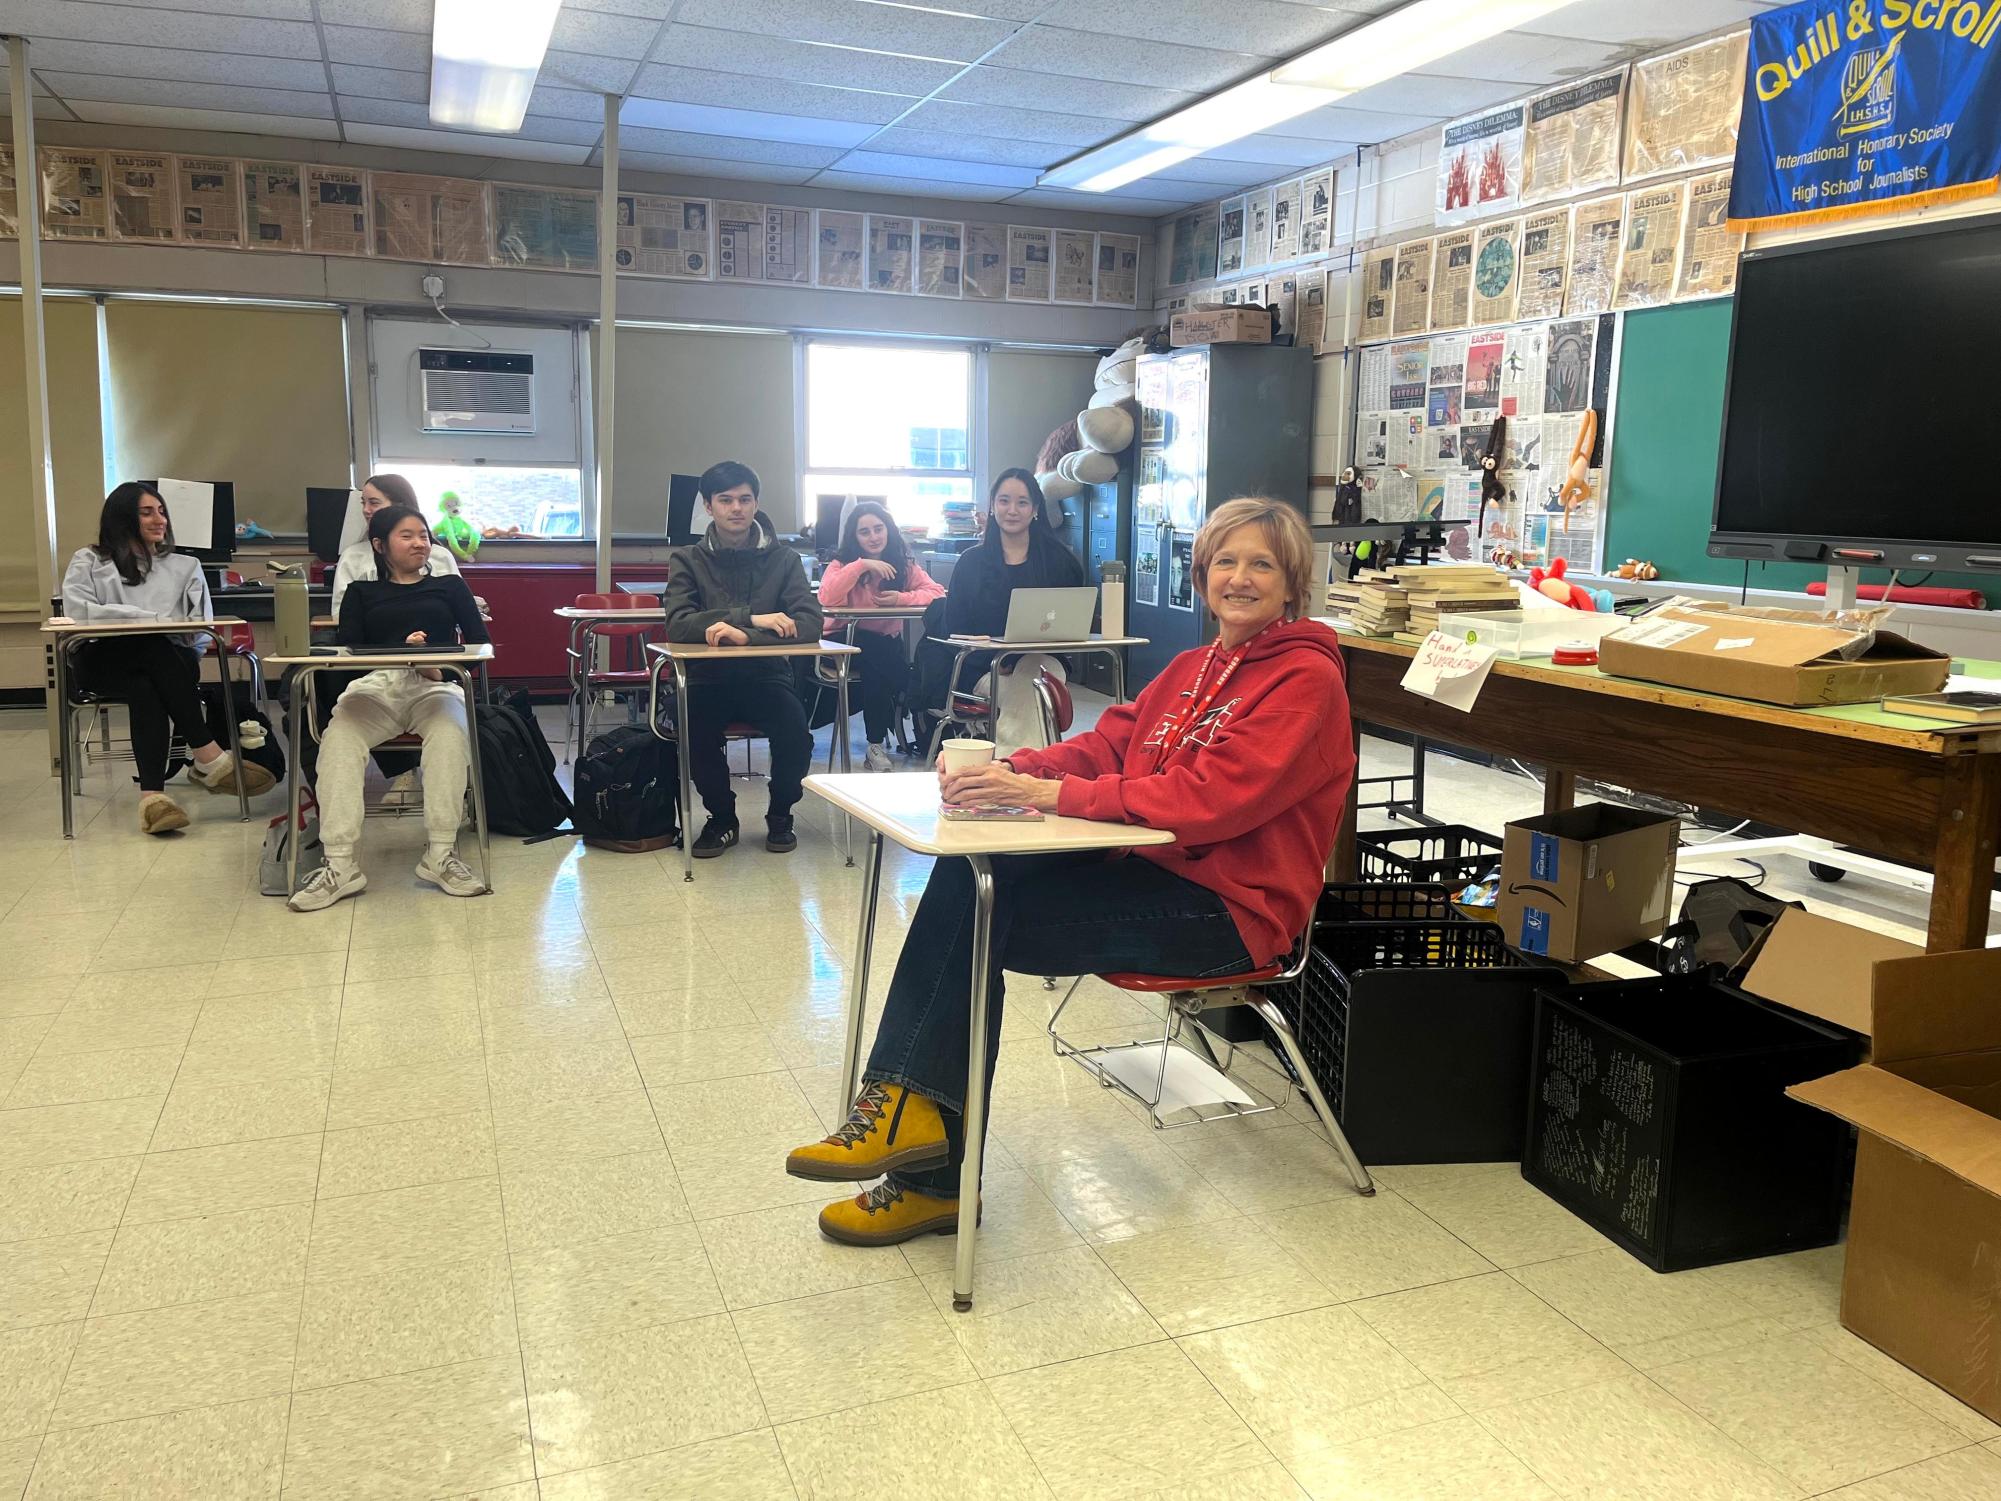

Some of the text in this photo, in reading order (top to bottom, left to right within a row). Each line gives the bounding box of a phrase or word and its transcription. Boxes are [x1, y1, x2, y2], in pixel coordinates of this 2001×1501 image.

[1665, 56, 1689, 73] AIDS
[1756, 0, 2001, 102] Quill & Scroll
[1776, 122, 1955, 170] International Honorary Society
[1857, 157, 1875, 172] for
[1792, 165, 1928, 203] High School Journalists
[1439, 234, 1470, 248] EASTSIDE
